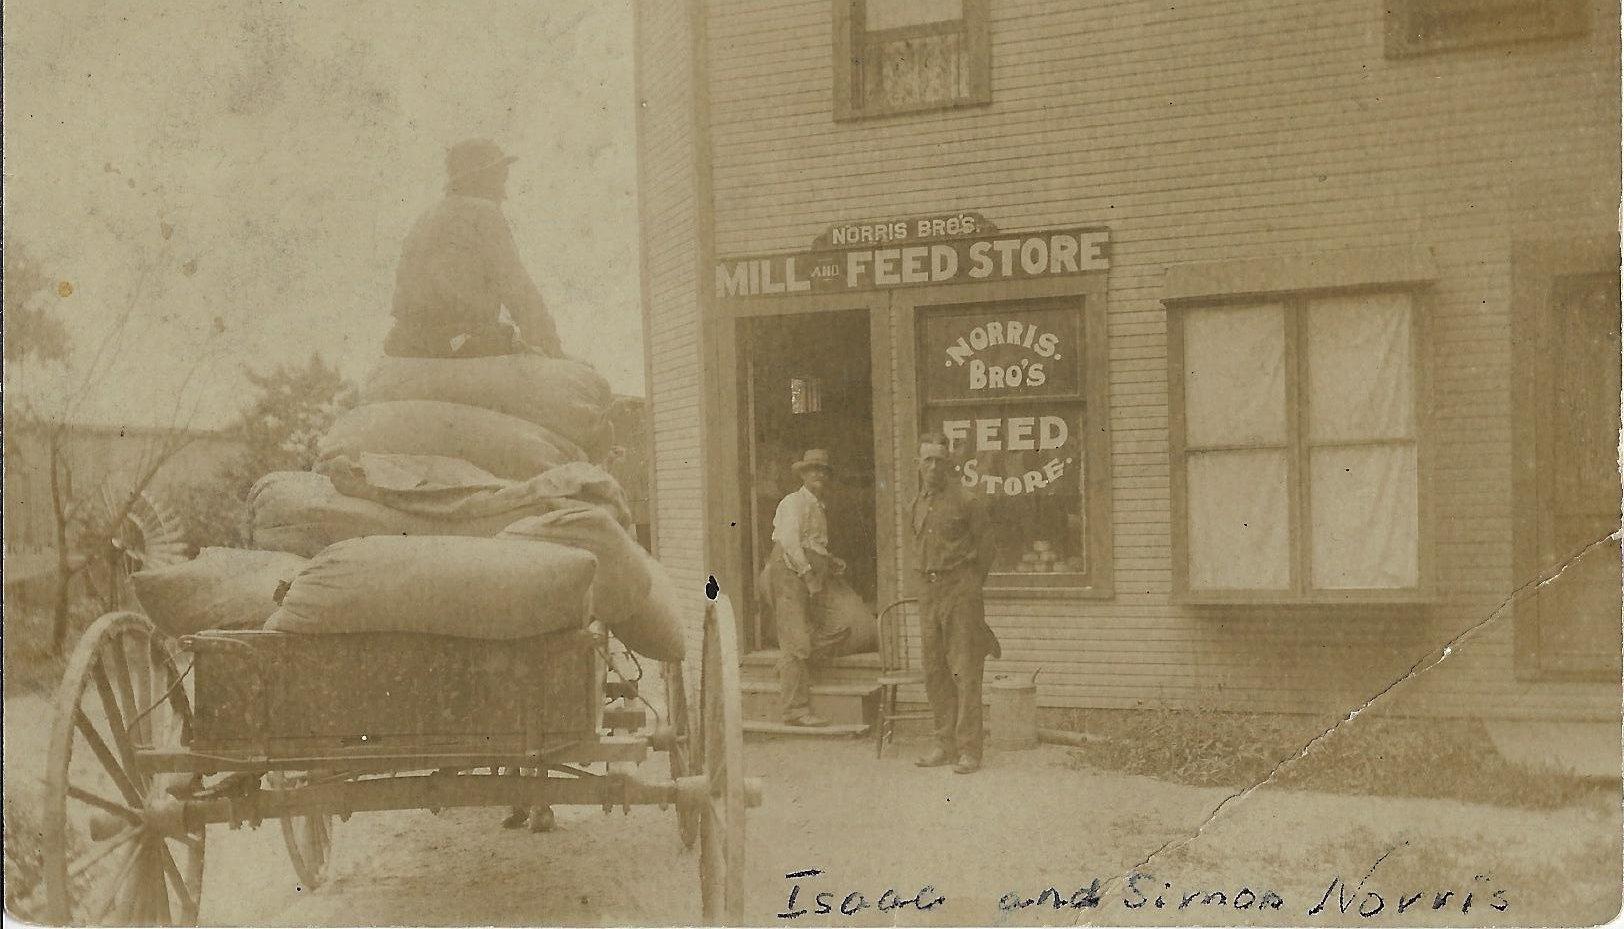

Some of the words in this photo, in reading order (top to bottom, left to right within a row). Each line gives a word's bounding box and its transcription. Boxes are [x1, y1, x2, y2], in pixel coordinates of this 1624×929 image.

[832, 223, 907, 245] NORRIS
[715, 258, 811, 298] MILL
[847, 245, 959, 288] FEED
[968, 232, 1109, 279] STORE
[943, 416, 1069, 451] FEED
[777, 869, 946, 919] Isaac
[999, 878, 1101, 911] and
[1124, 872, 1285, 911] Simon
[1308, 847, 1509, 918] Norris
